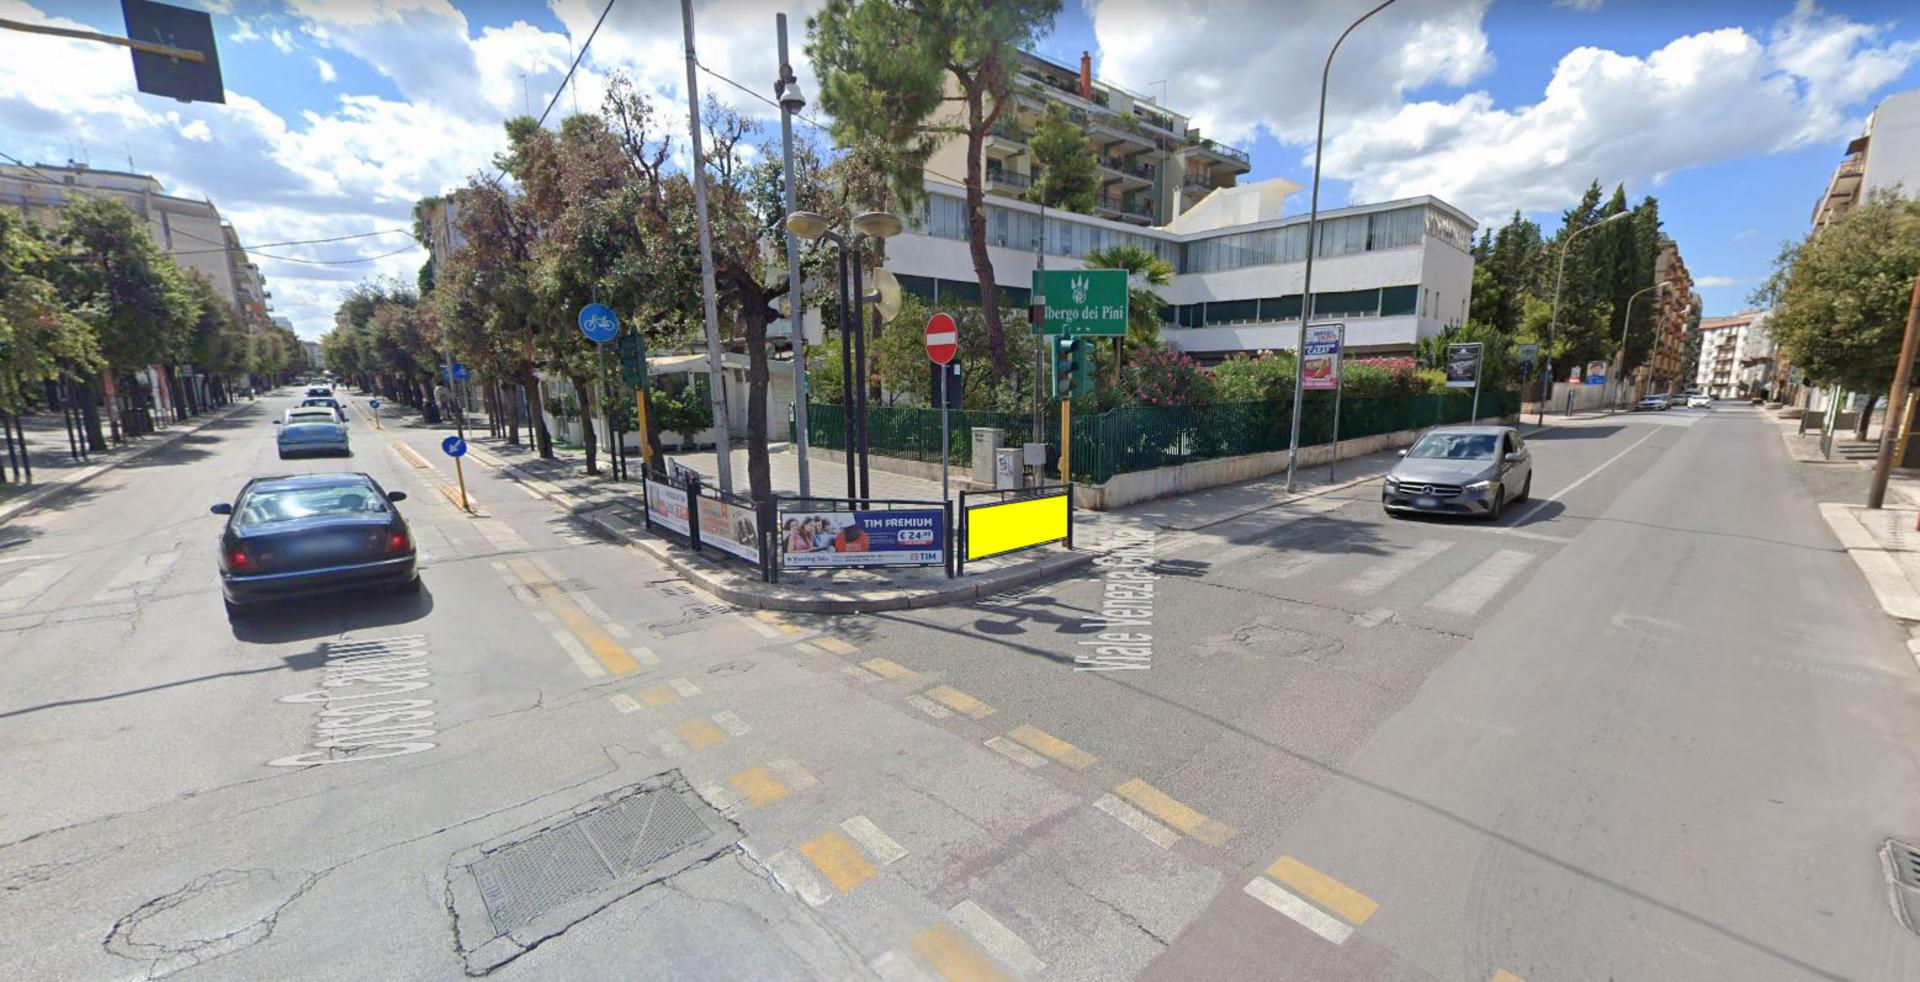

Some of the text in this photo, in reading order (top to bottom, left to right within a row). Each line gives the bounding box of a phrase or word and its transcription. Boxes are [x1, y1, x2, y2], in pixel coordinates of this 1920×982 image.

[1044, 306, 1123, 323] lbergo dei Pini
[864, 518, 933, 528] TIM PREMIUM
[920, 553, 936, 561] TIM
